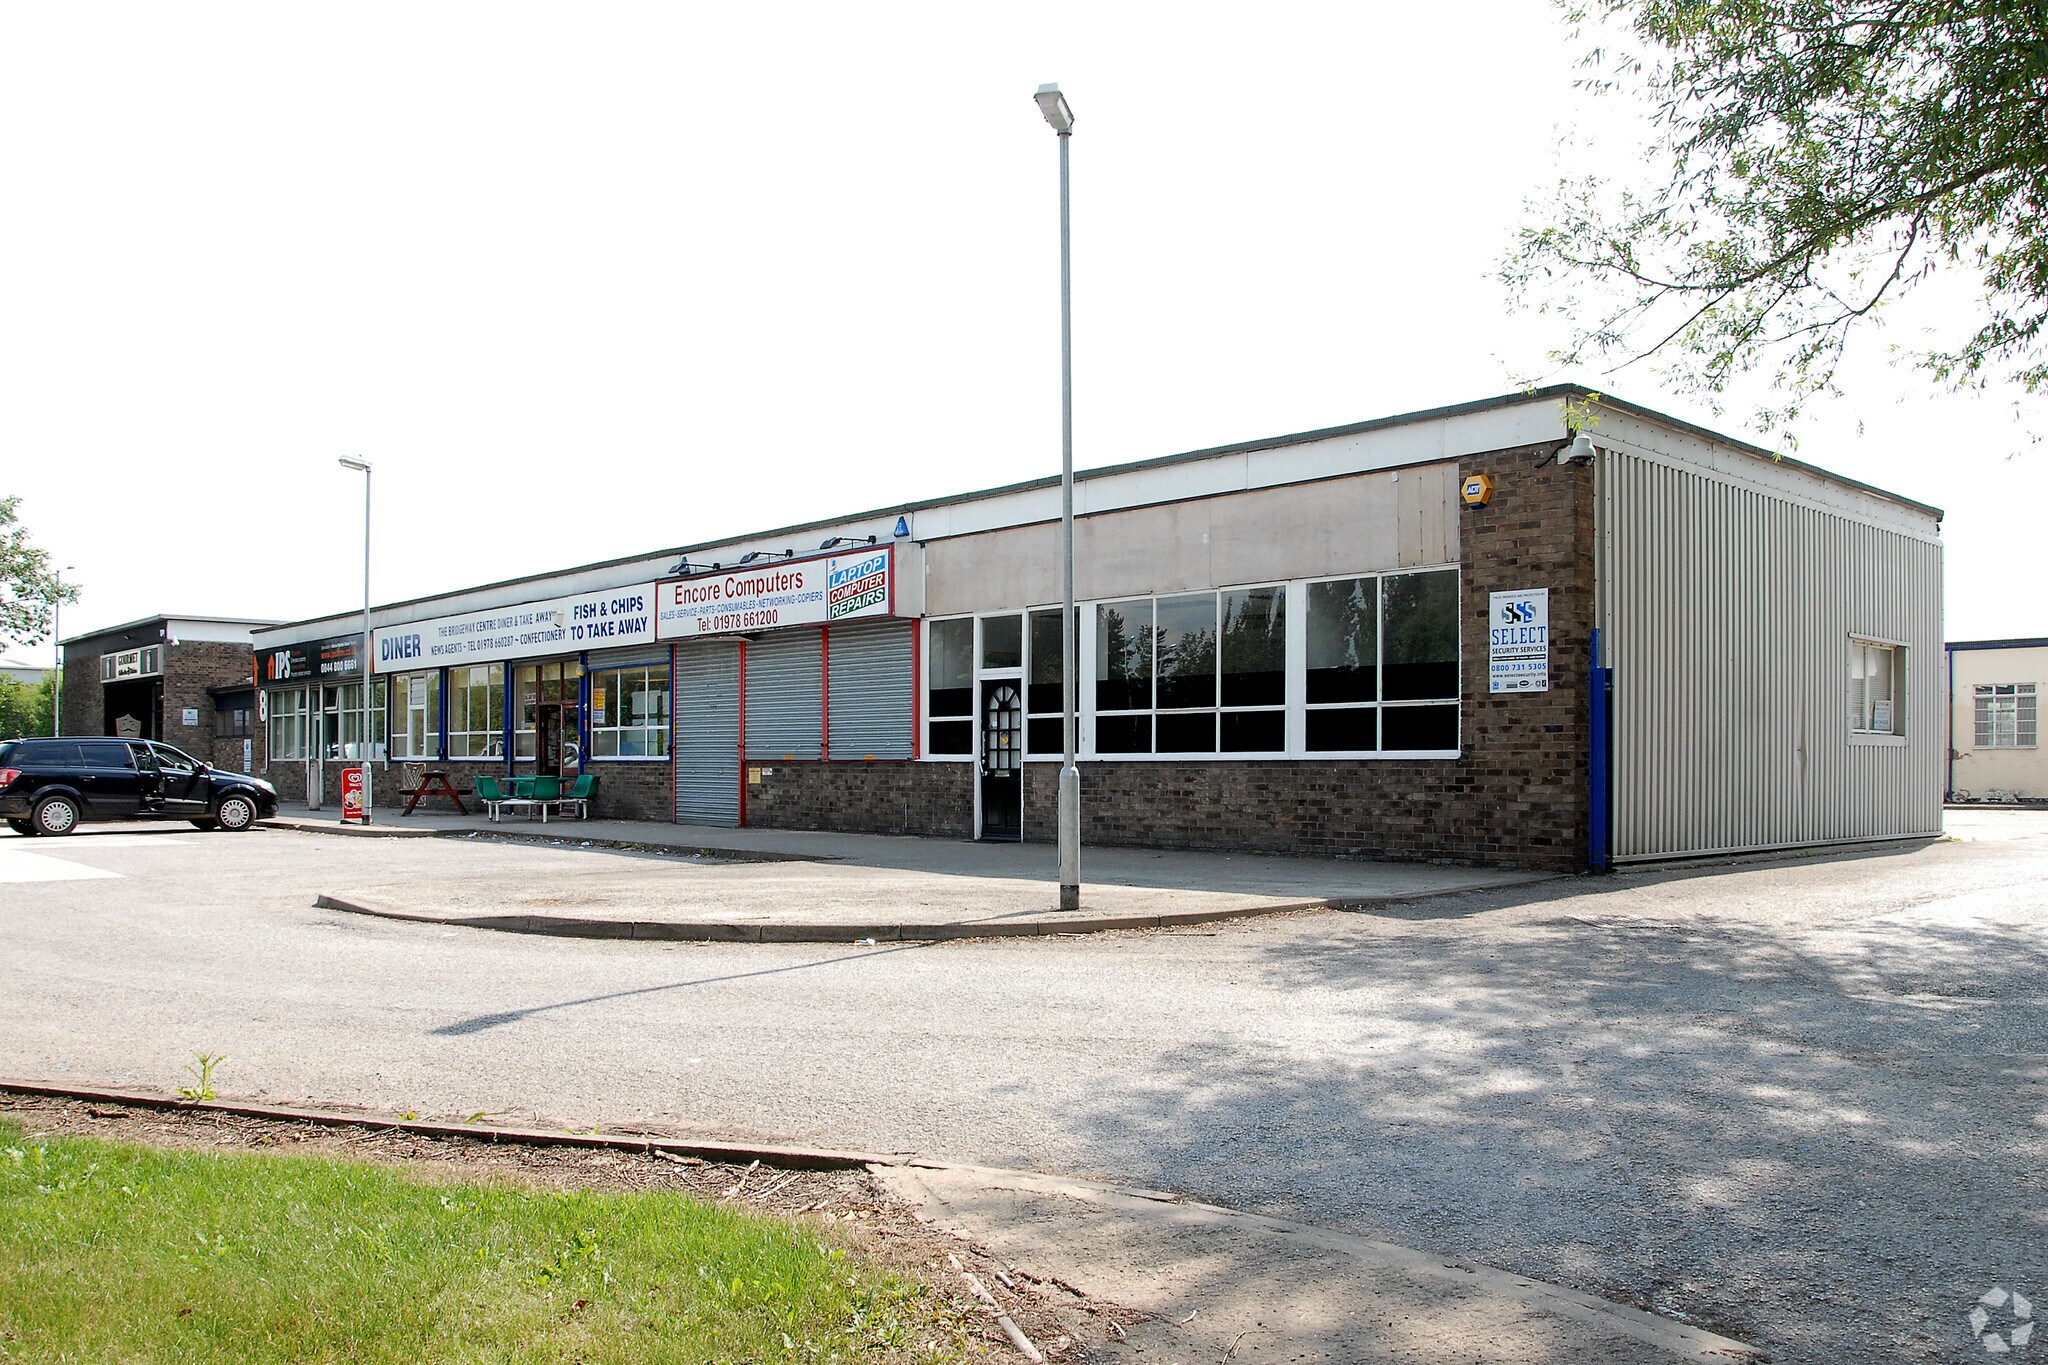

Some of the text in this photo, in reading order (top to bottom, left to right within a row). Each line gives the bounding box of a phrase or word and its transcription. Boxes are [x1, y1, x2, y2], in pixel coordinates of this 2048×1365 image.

[1467, 485, 1480, 494] ADT
[831, 557, 882, 587] LAPTOP
[675, 571, 803, 605] Encore Computers
[831, 573, 883, 602] COMPUTER
[574, 596, 643, 620] FISH & CHIPS
[831, 590, 884, 619] REPAIRS
[438, 611, 552, 637] THE BRIDGEWAY CENTRE DINER & TAKE AWAY
[571, 617, 648, 640] TO TAKE AWAY
[697, 609, 778, 632] Tel: 01978 661200
[382, 633, 421, 661] DINER
[468, 640, 476, 651] TEL
[477, 638, 493, 650] 01978
[494, 635, 514, 649] 660287
[520, 629, 566, 645] CONFECTIONERY
[1492, 626, 1546, 645] SELECT
[118, 652, 138, 666] GOURMET
[275, 650, 290, 680] IPS
[321, 663, 333, 673] 0844
[333, 660, 343, 672] 800
[1491, 664, 1509, 672] 0800
[259, 690, 267, 722] 8
